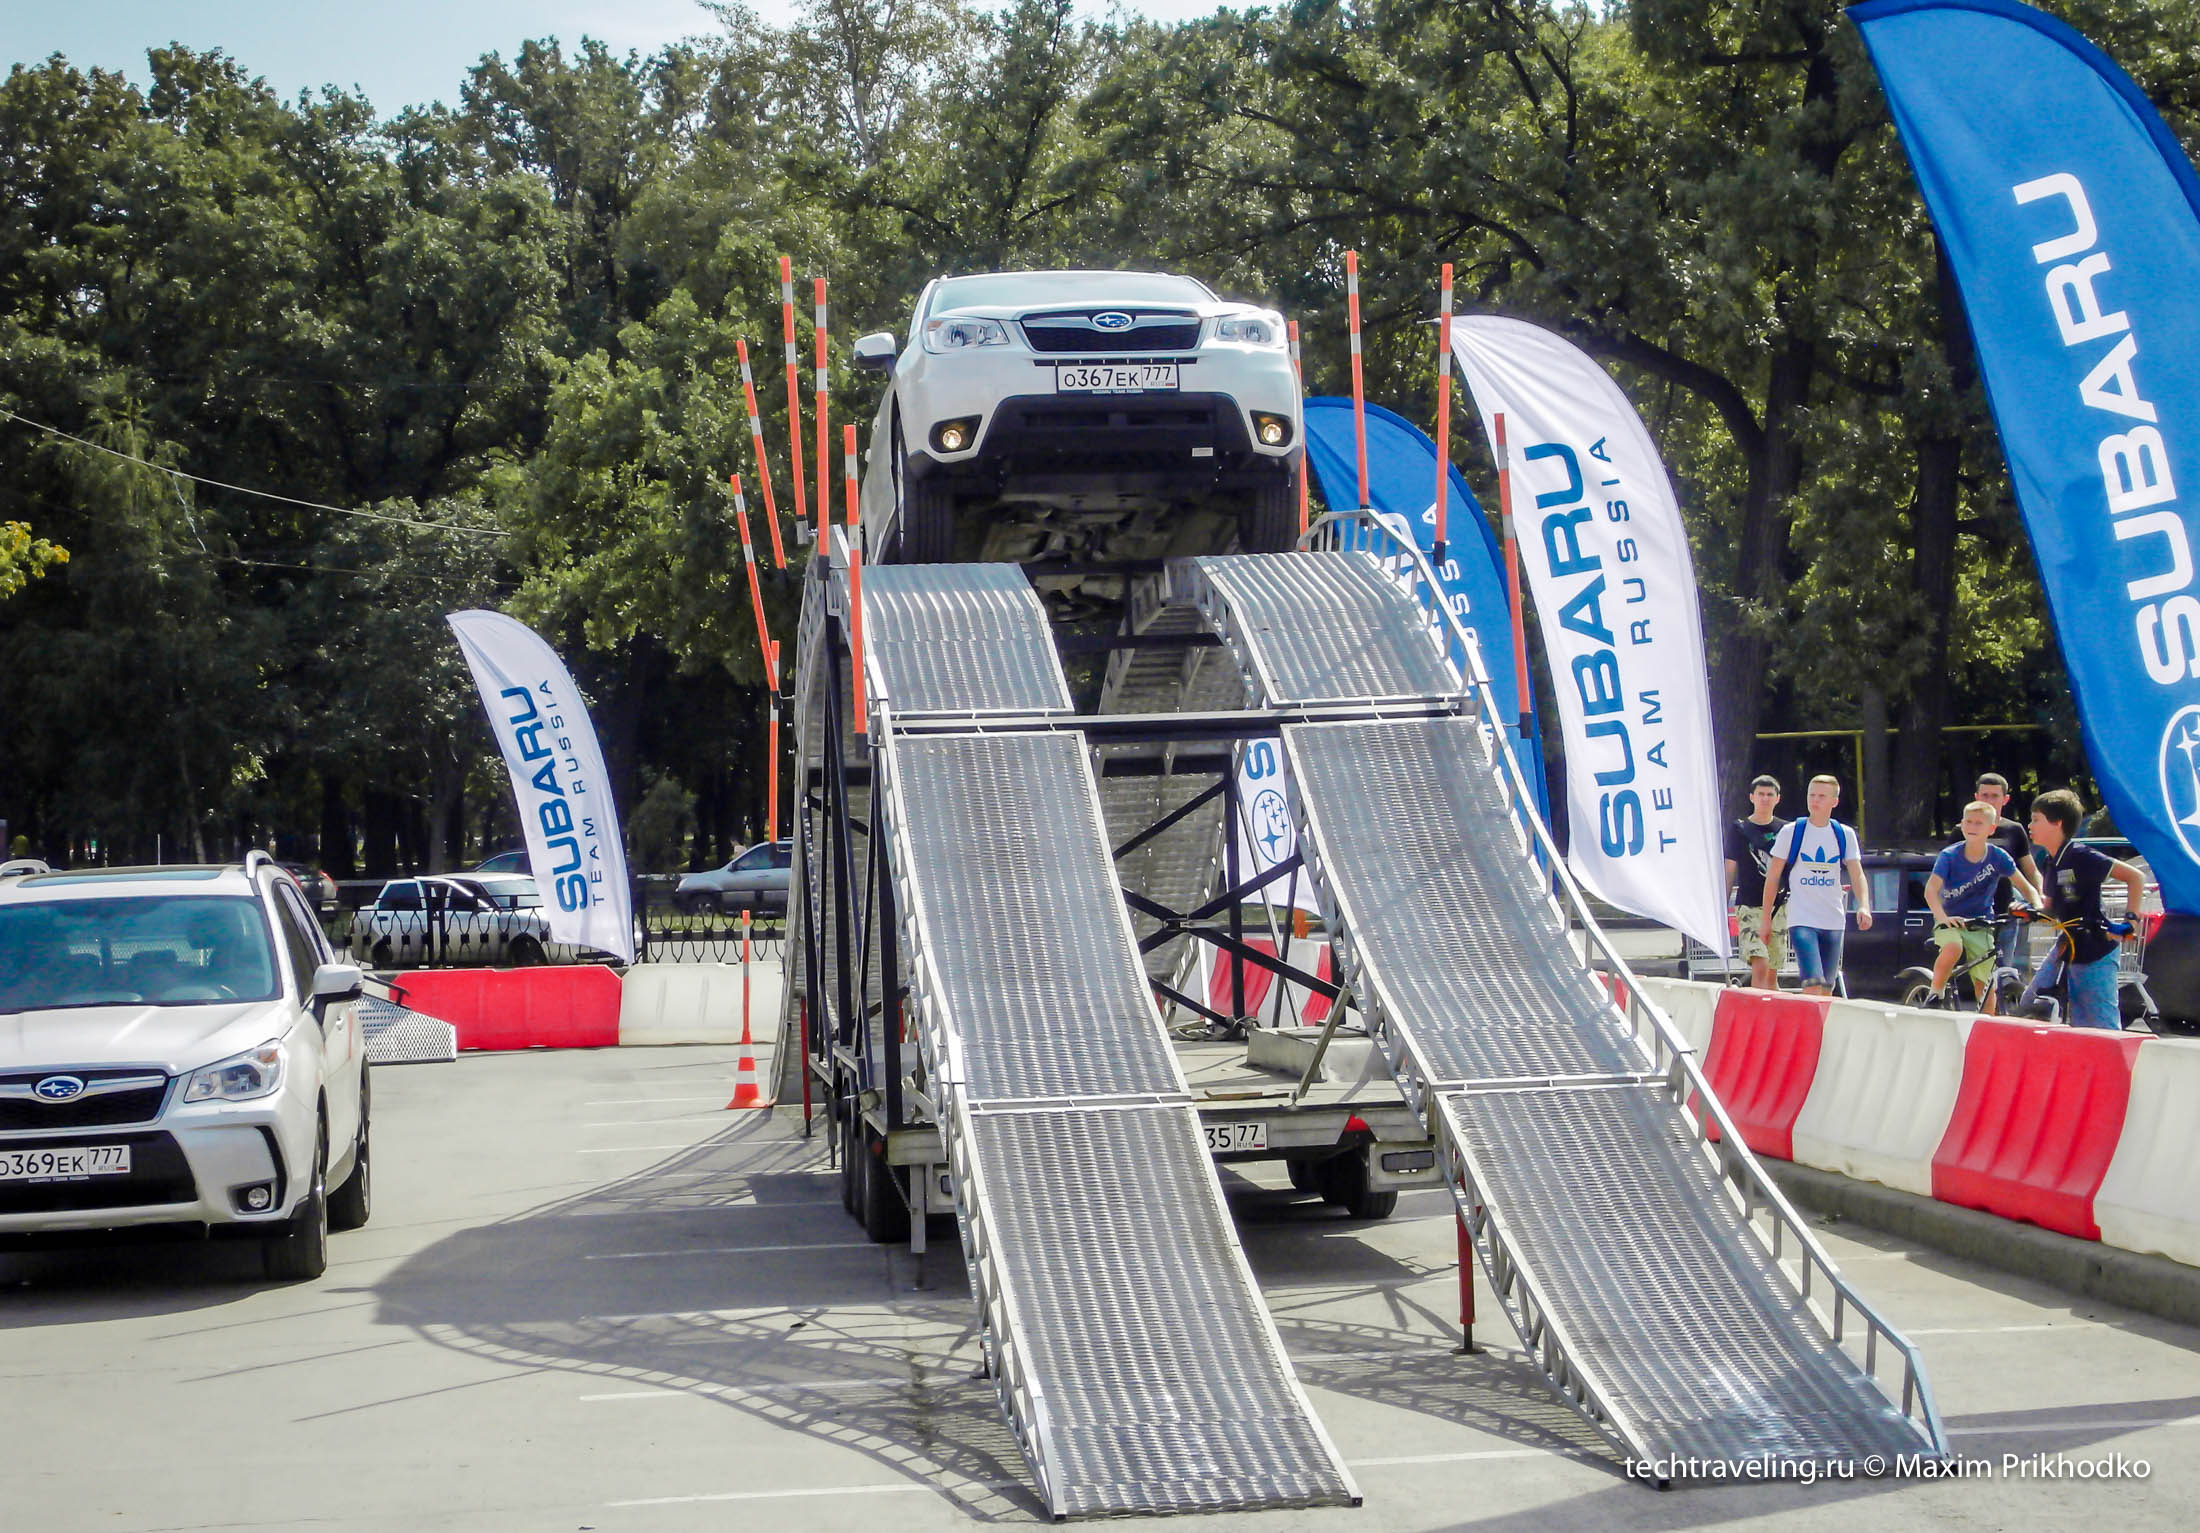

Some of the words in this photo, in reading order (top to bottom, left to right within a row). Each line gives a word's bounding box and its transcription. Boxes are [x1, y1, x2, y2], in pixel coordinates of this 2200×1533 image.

[1143, 366, 1171, 381] 777
[2013, 172, 2200, 686] SUBARU
[1589, 436, 1653, 646] RUSSIA
[1524, 442, 1645, 858] SUBARU
[539, 680, 587, 795] RUSSIA
[1642, 689, 1678, 854] TEAM
[500, 686, 588, 912] SUBARU
[582, 817, 605, 906] TEAM
[1800, 876, 1836, 887] adida
[89, 1147, 123, 1165] 777
[1237, 1125, 1259, 1142] 77
